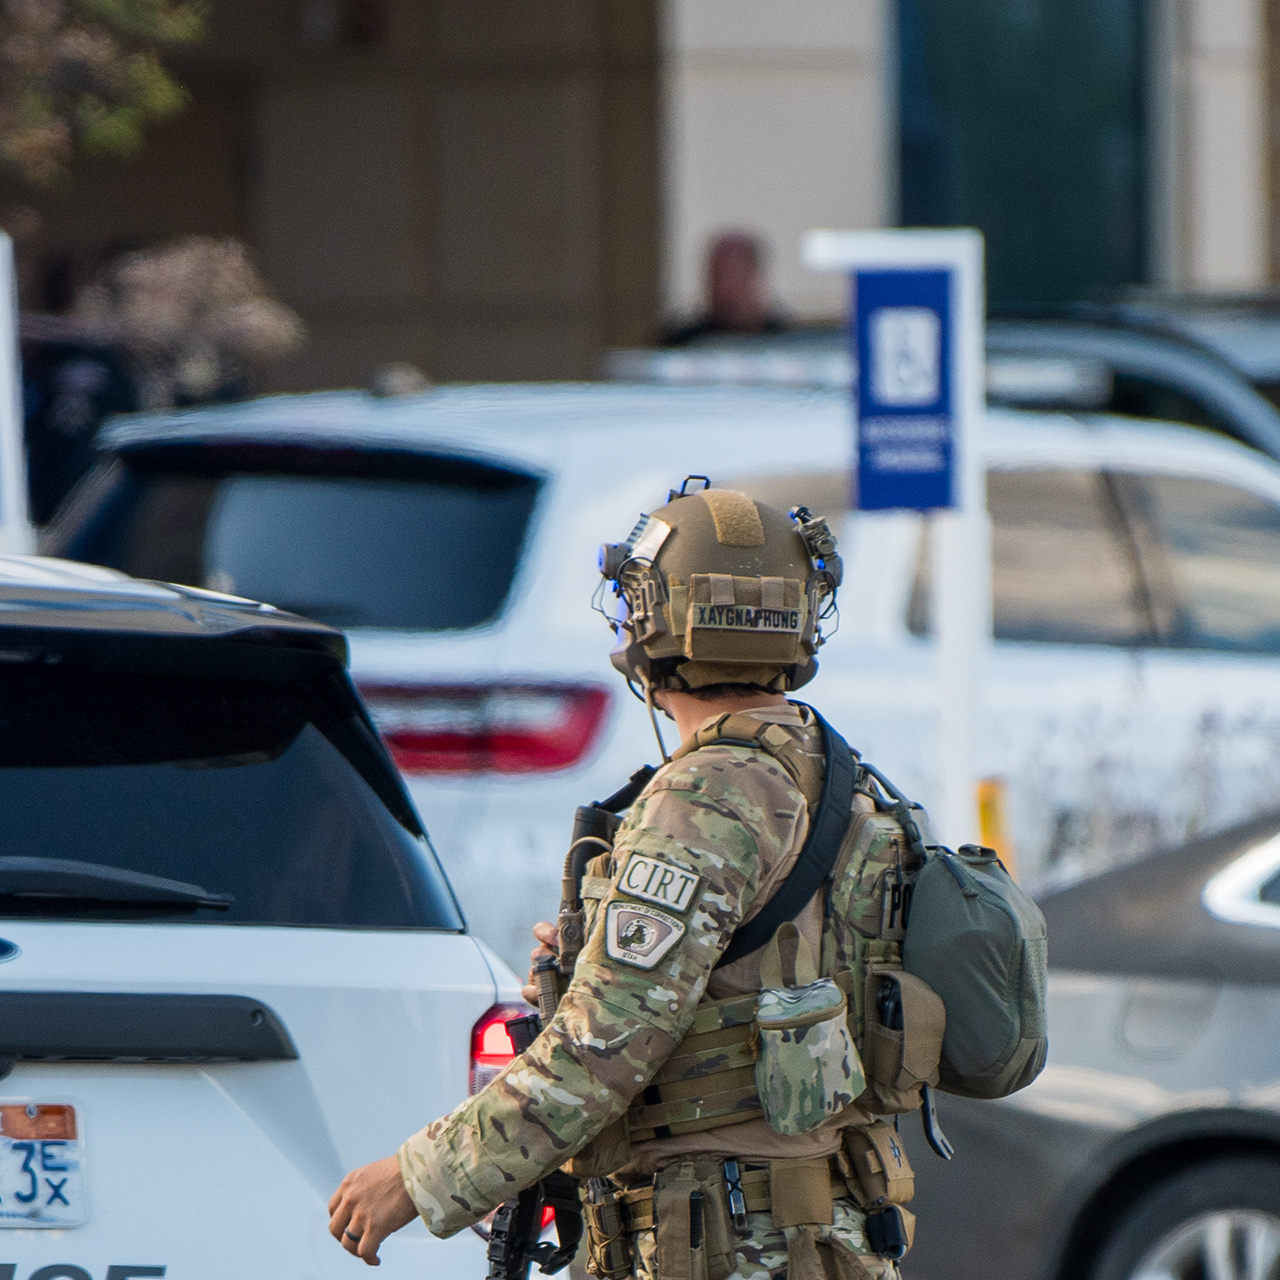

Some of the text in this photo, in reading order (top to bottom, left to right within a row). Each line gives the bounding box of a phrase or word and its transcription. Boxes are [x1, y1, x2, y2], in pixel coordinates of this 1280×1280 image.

[626, 859, 695, 905] CIRT
[612, 903, 644, 912] DEPARTMENT
[650, 909, 684, 931] CORRECTIONS
[622, 952, 639, 961] UTAH
